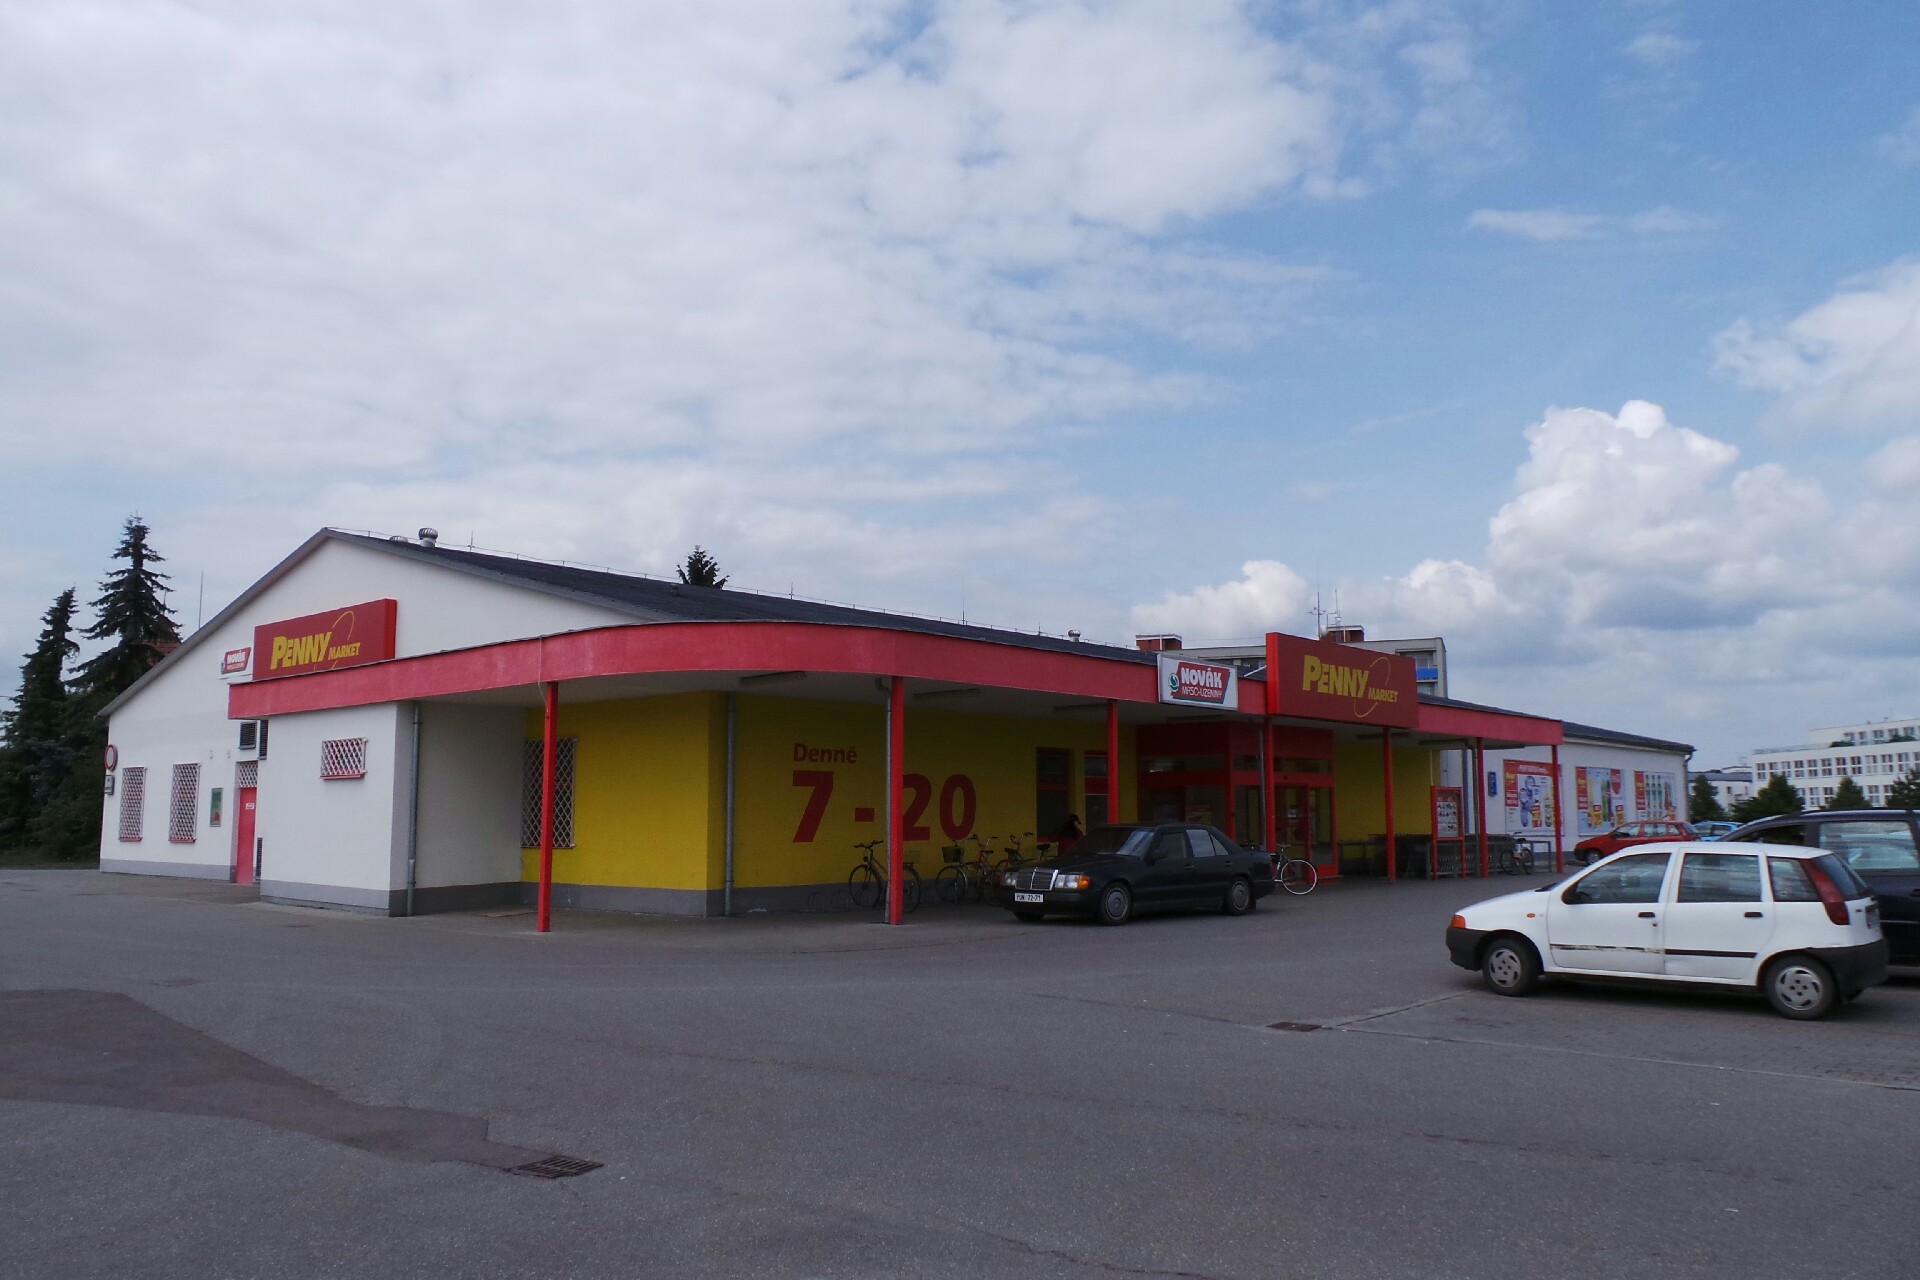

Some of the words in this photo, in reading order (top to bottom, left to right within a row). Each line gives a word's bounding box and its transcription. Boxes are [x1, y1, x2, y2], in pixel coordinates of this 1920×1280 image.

[271, 631, 332, 670] PENNY
[327, 642, 361, 661] MARKET
[1181, 667, 1222, 688] NOVÁK
[1302, 655, 1369, 698] PENNY
[1368, 687, 1398, 703] MARKET
[793, 743, 857, 764] Denně
[793, 770, 834, 842] 7
[901, 773, 977, 841] 20
